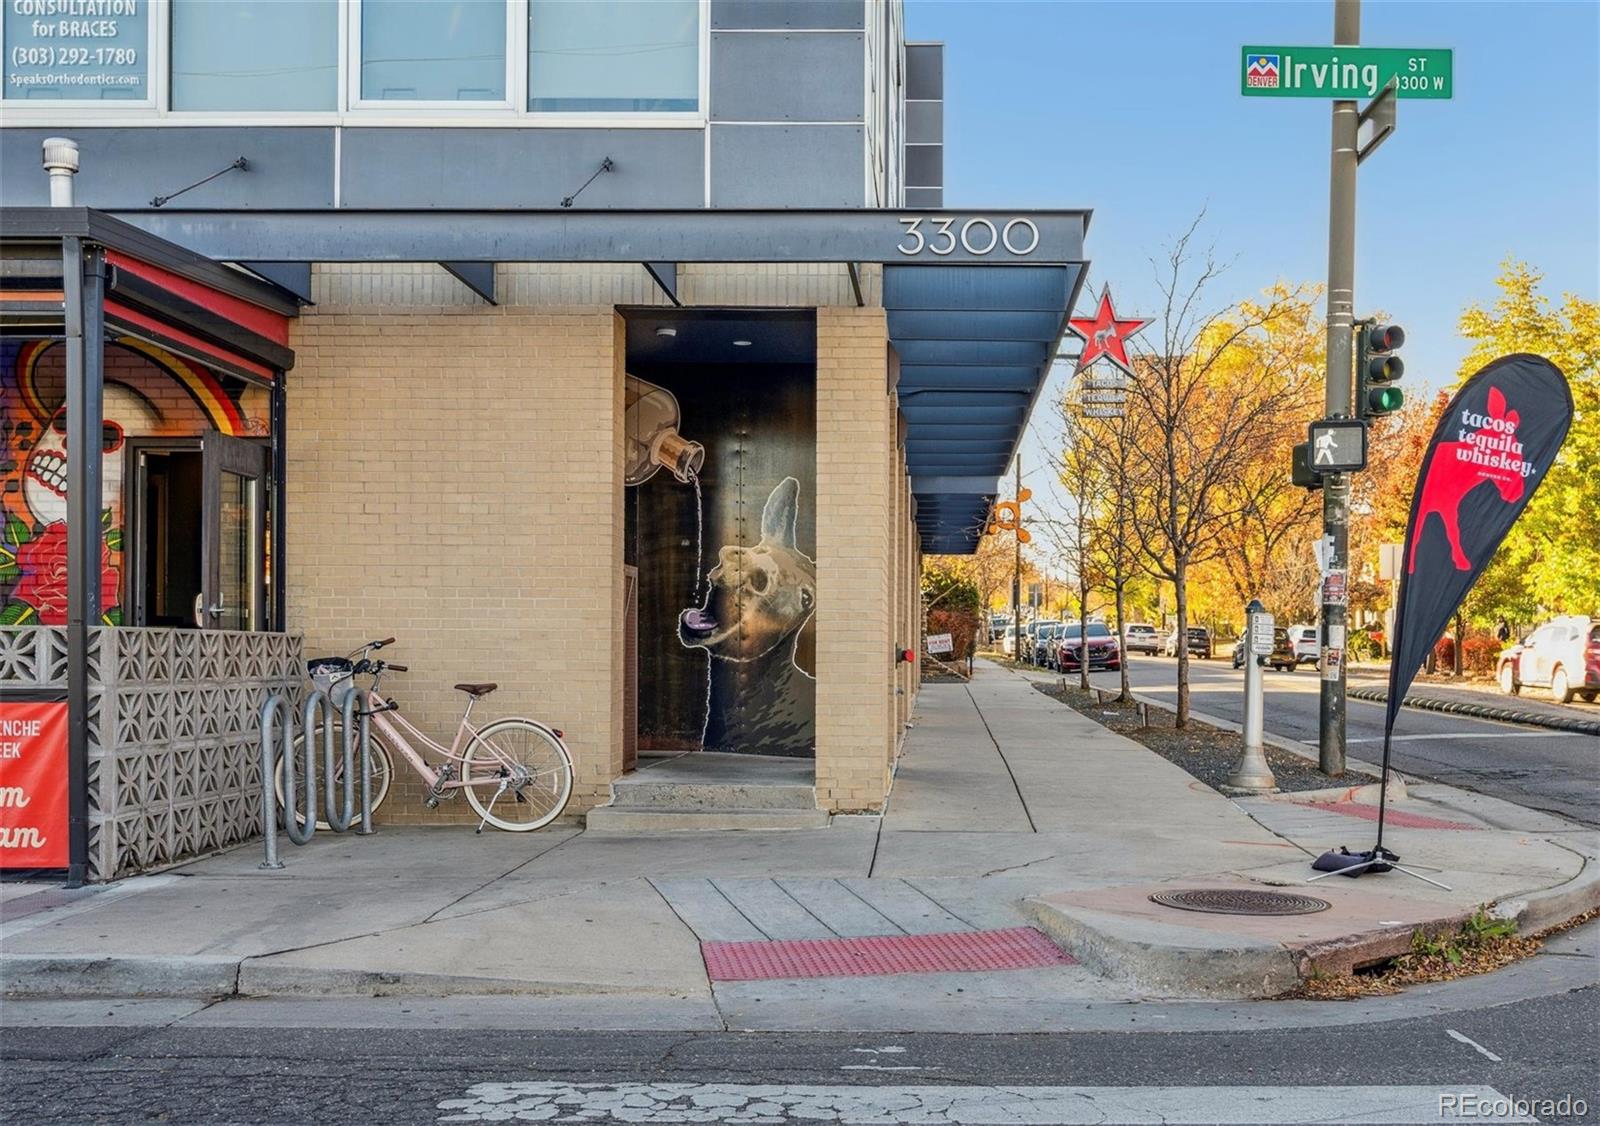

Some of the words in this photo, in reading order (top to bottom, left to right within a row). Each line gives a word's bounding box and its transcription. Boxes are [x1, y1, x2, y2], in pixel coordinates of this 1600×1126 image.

[14, 0, 136, 15] CONSULTATION
[32, 20, 55, 37] for
[60, 20, 117, 37] BRACES
[12, 47, 55, 66] (303)
[58, 48, 136, 65] 292-1780
[1408, 57, 1427, 72] ST
[10, 73, 140, 86] SpeaksOrthodontics.com
[1248, 76, 1278, 87] DENVER
[1284, 56, 1377, 96] Irving
[1433, 76, 1444, 90] W
[897, 217, 1040, 255] 3300
[1461, 409, 1516, 434] tacos
[1458, 428, 1524, 454] tequila
[1456, 446, 1537, 477] whiskey.
[0, 720, 41, 736] NCHE
[0, 742, 21, 758] EK
